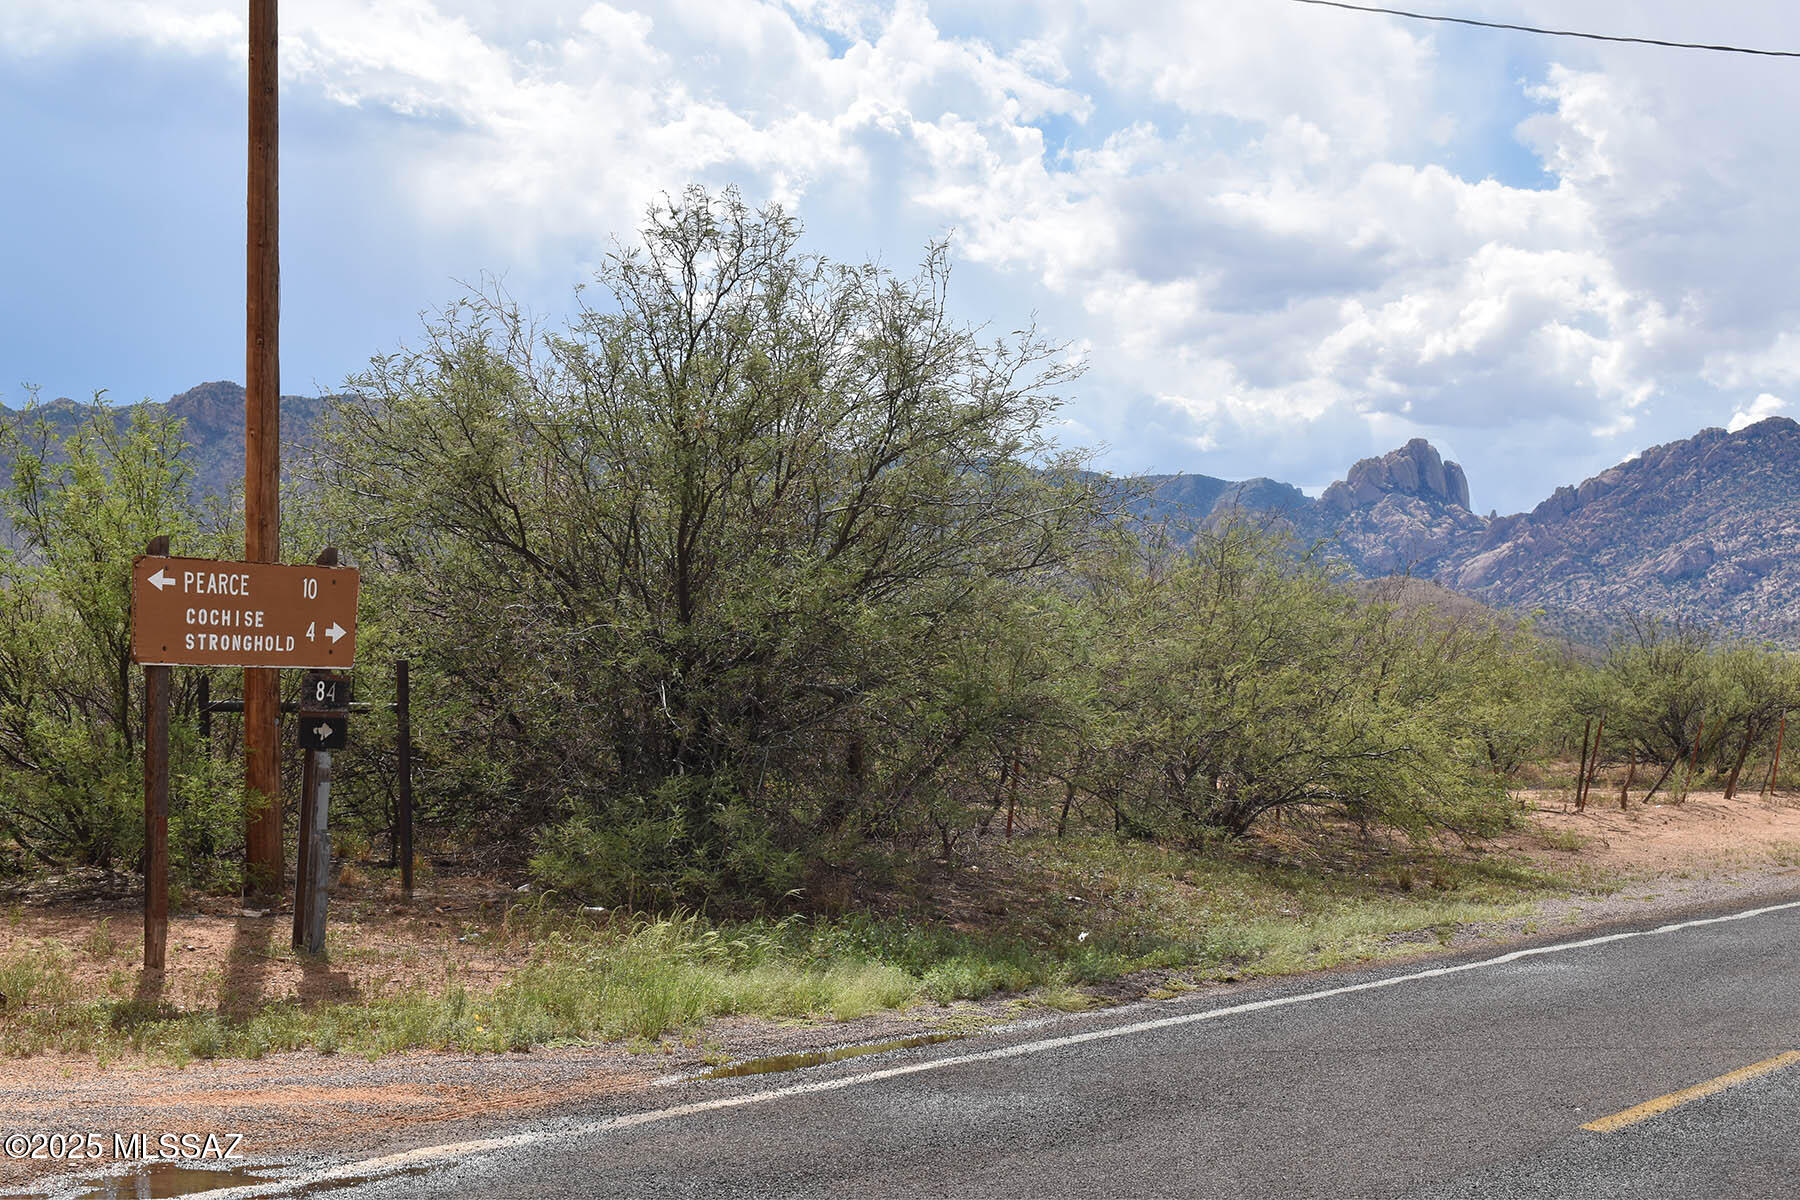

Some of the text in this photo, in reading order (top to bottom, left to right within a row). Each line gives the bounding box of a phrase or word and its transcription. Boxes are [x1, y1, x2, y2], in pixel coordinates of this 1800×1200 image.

[184, 571, 318, 599] PEARCE 10
[186, 608, 264, 628] COCHISE
[305, 622, 316, 642] 4
[185, 633, 295, 652] STRONGHOLD
[315, 680, 336, 703] 84
